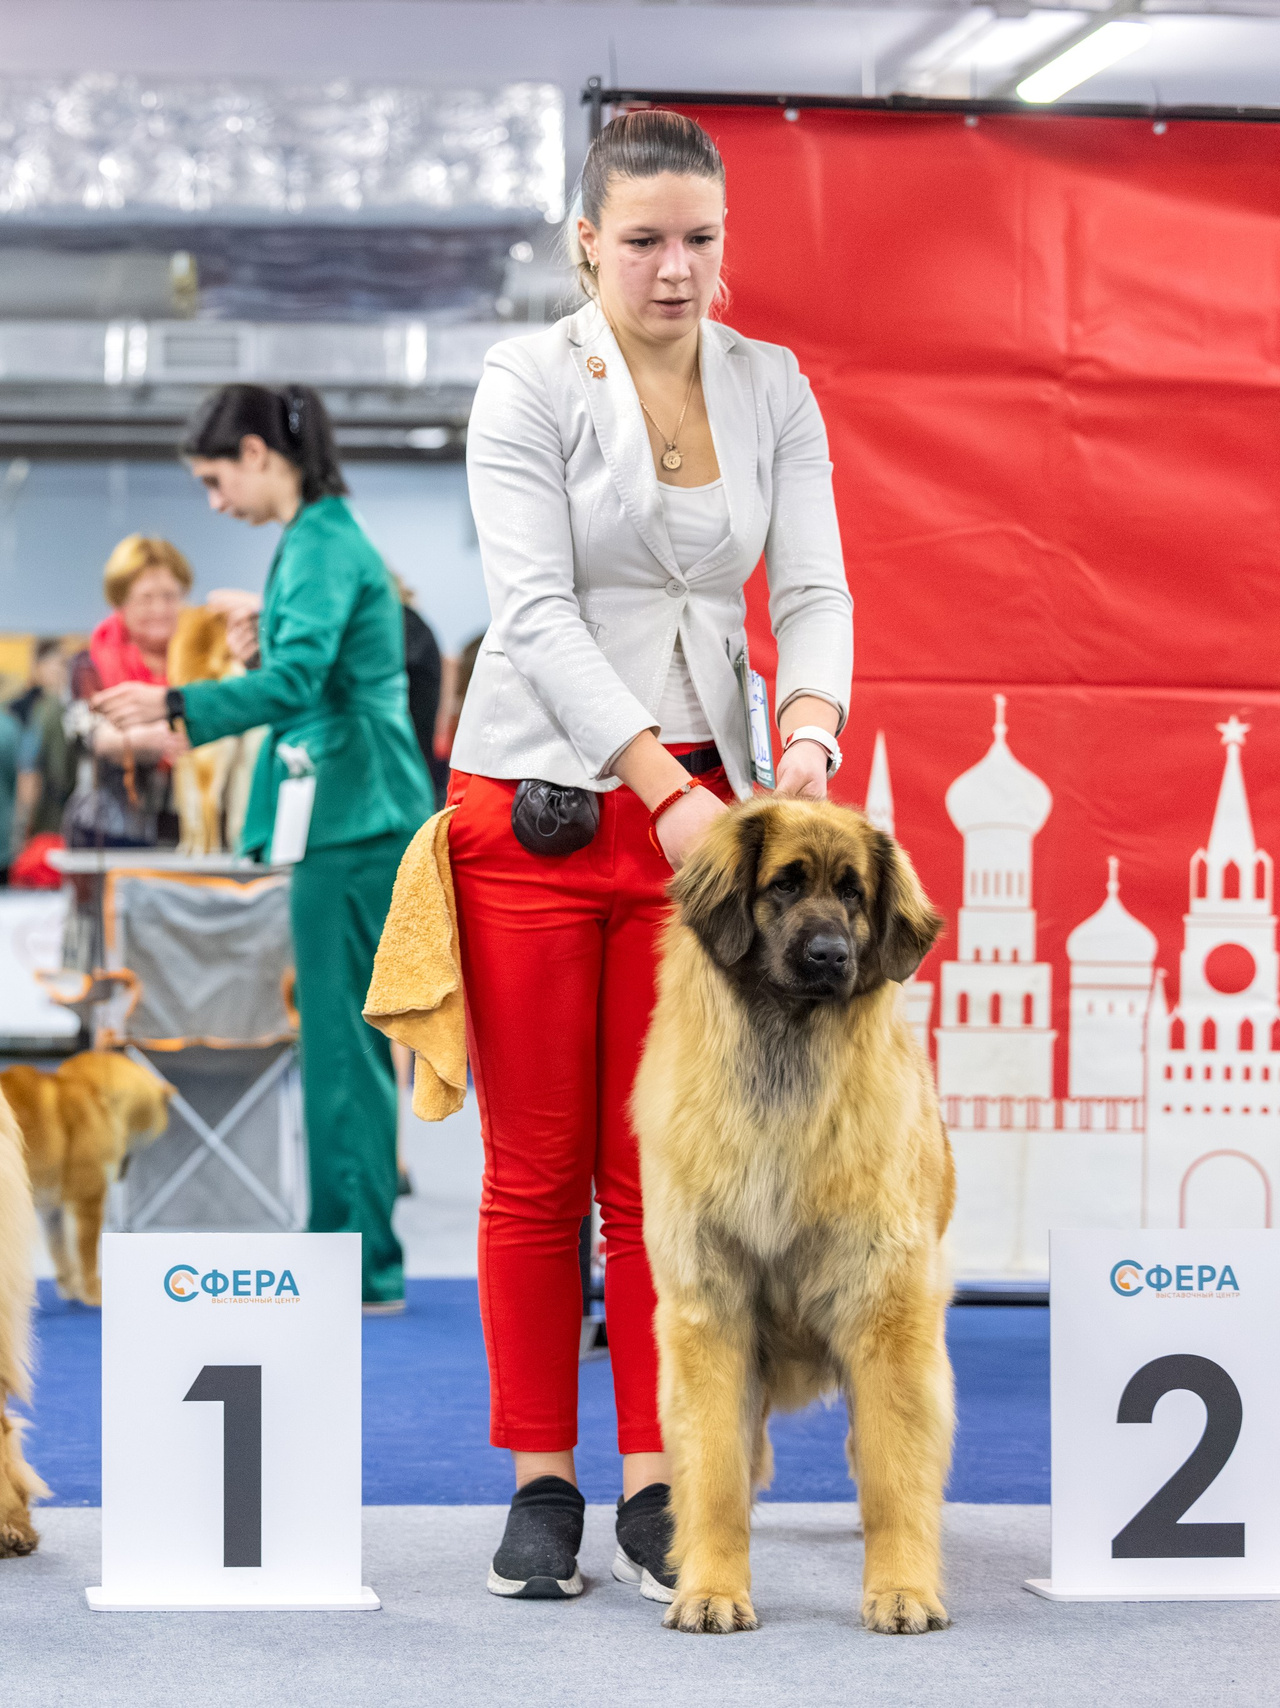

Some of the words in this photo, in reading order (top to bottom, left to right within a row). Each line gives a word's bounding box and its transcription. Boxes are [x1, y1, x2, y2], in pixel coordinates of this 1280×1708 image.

[163, 1264, 300, 1303] СФЕРА
[1110, 1259, 1240, 1297] СФЕРА
[1155, 1291, 1214, 1299] ВЫСТАВОЧНЫЙ
[1216, 1291, 1241, 1299] ЦЕНТР
[211, 1296, 273, 1304] ВЫСТАВОЧНЫЙ
[182, 1364, 262, 1568] 1
[1111, 1353, 1246, 1559] 2
